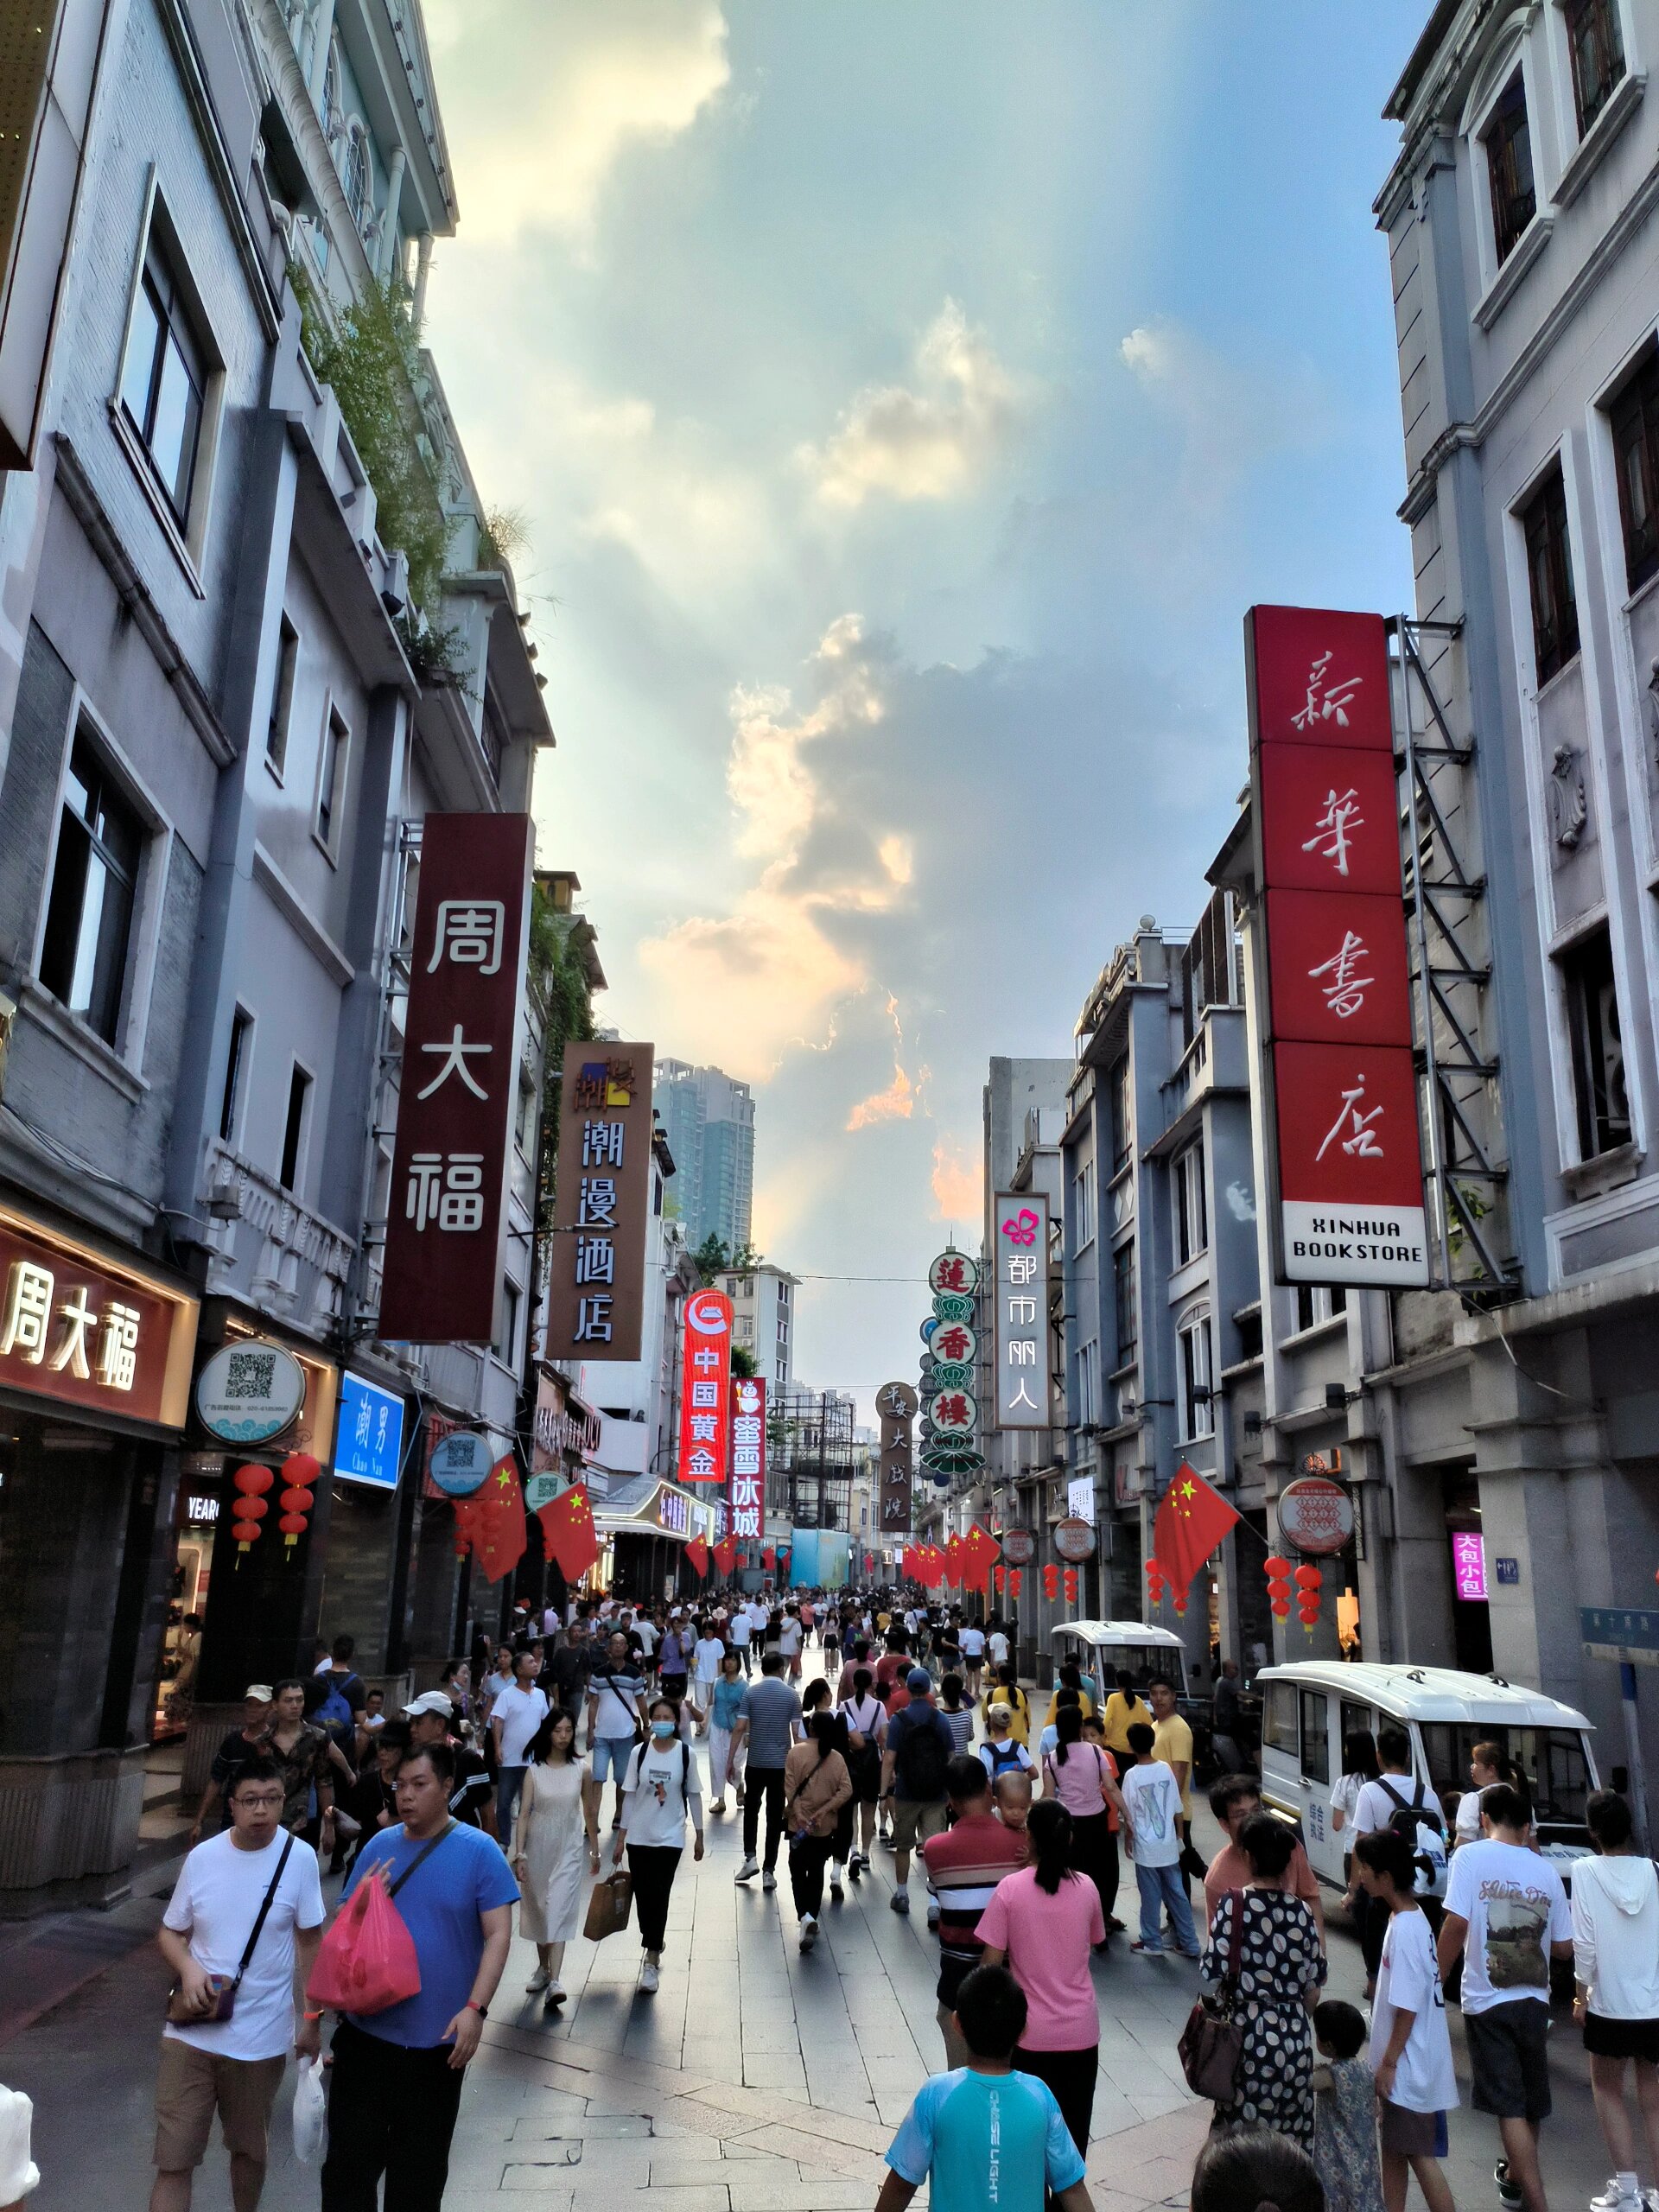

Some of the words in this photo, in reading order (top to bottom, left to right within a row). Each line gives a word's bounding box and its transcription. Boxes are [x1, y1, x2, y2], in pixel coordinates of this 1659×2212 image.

[405, 899, 505, 1233] 周大福
[573, 1118, 626, 1344] 潮漫酒店
[1294, 1241, 1423, 1262] BOOKSTORE
[1313, 1218, 1400, 1236] XINHUA
[0, 1261, 141, 1391] 周大福
[1007, 1255, 1038, 1409] 都市丽人
[689, 1347, 719, 1476] 中国黄金
[732, 1415, 761, 1537] 蜜雪冰城
[1457, 1535, 1482, 1592] 大包小包
[988, 2148, 1000, 2203] LIGHT
